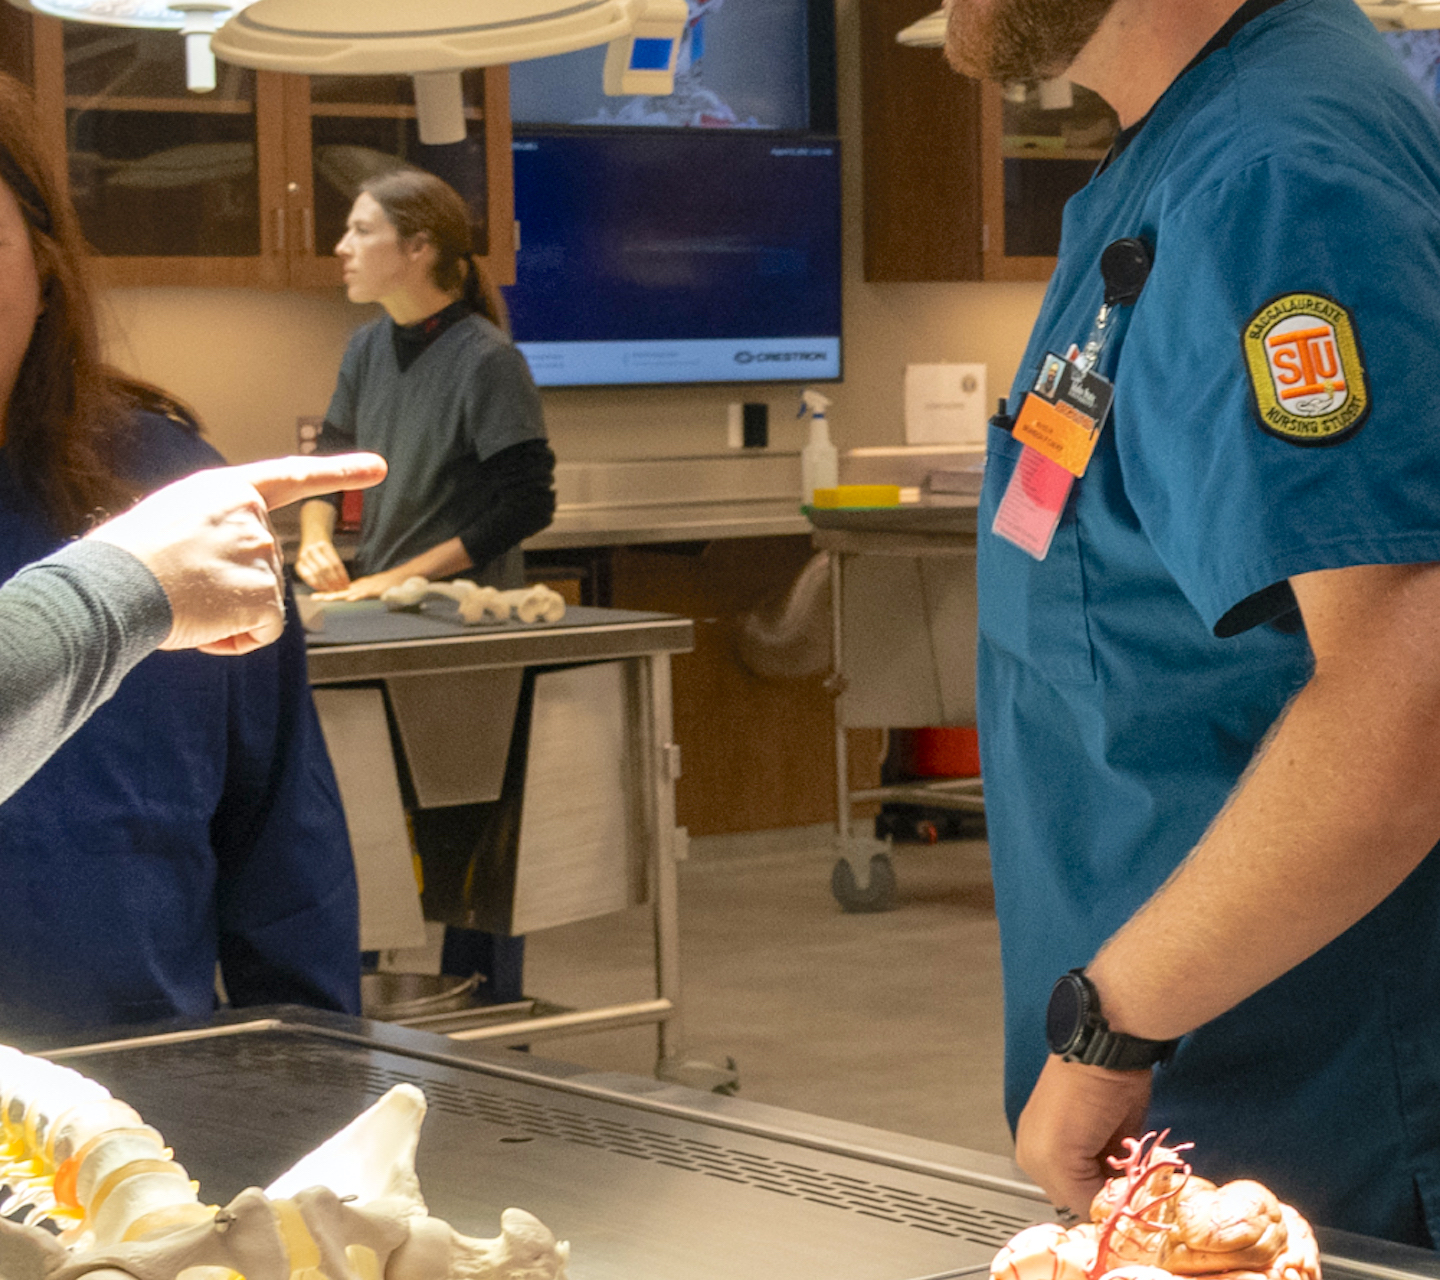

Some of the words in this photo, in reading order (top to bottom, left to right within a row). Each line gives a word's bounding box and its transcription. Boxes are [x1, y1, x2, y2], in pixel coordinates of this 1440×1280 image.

[1249, 299, 1344, 340] BACCALAUREATE
[1266, 407, 1319, 433] NURSING
[1322, 395, 1362, 432] STUDENT
